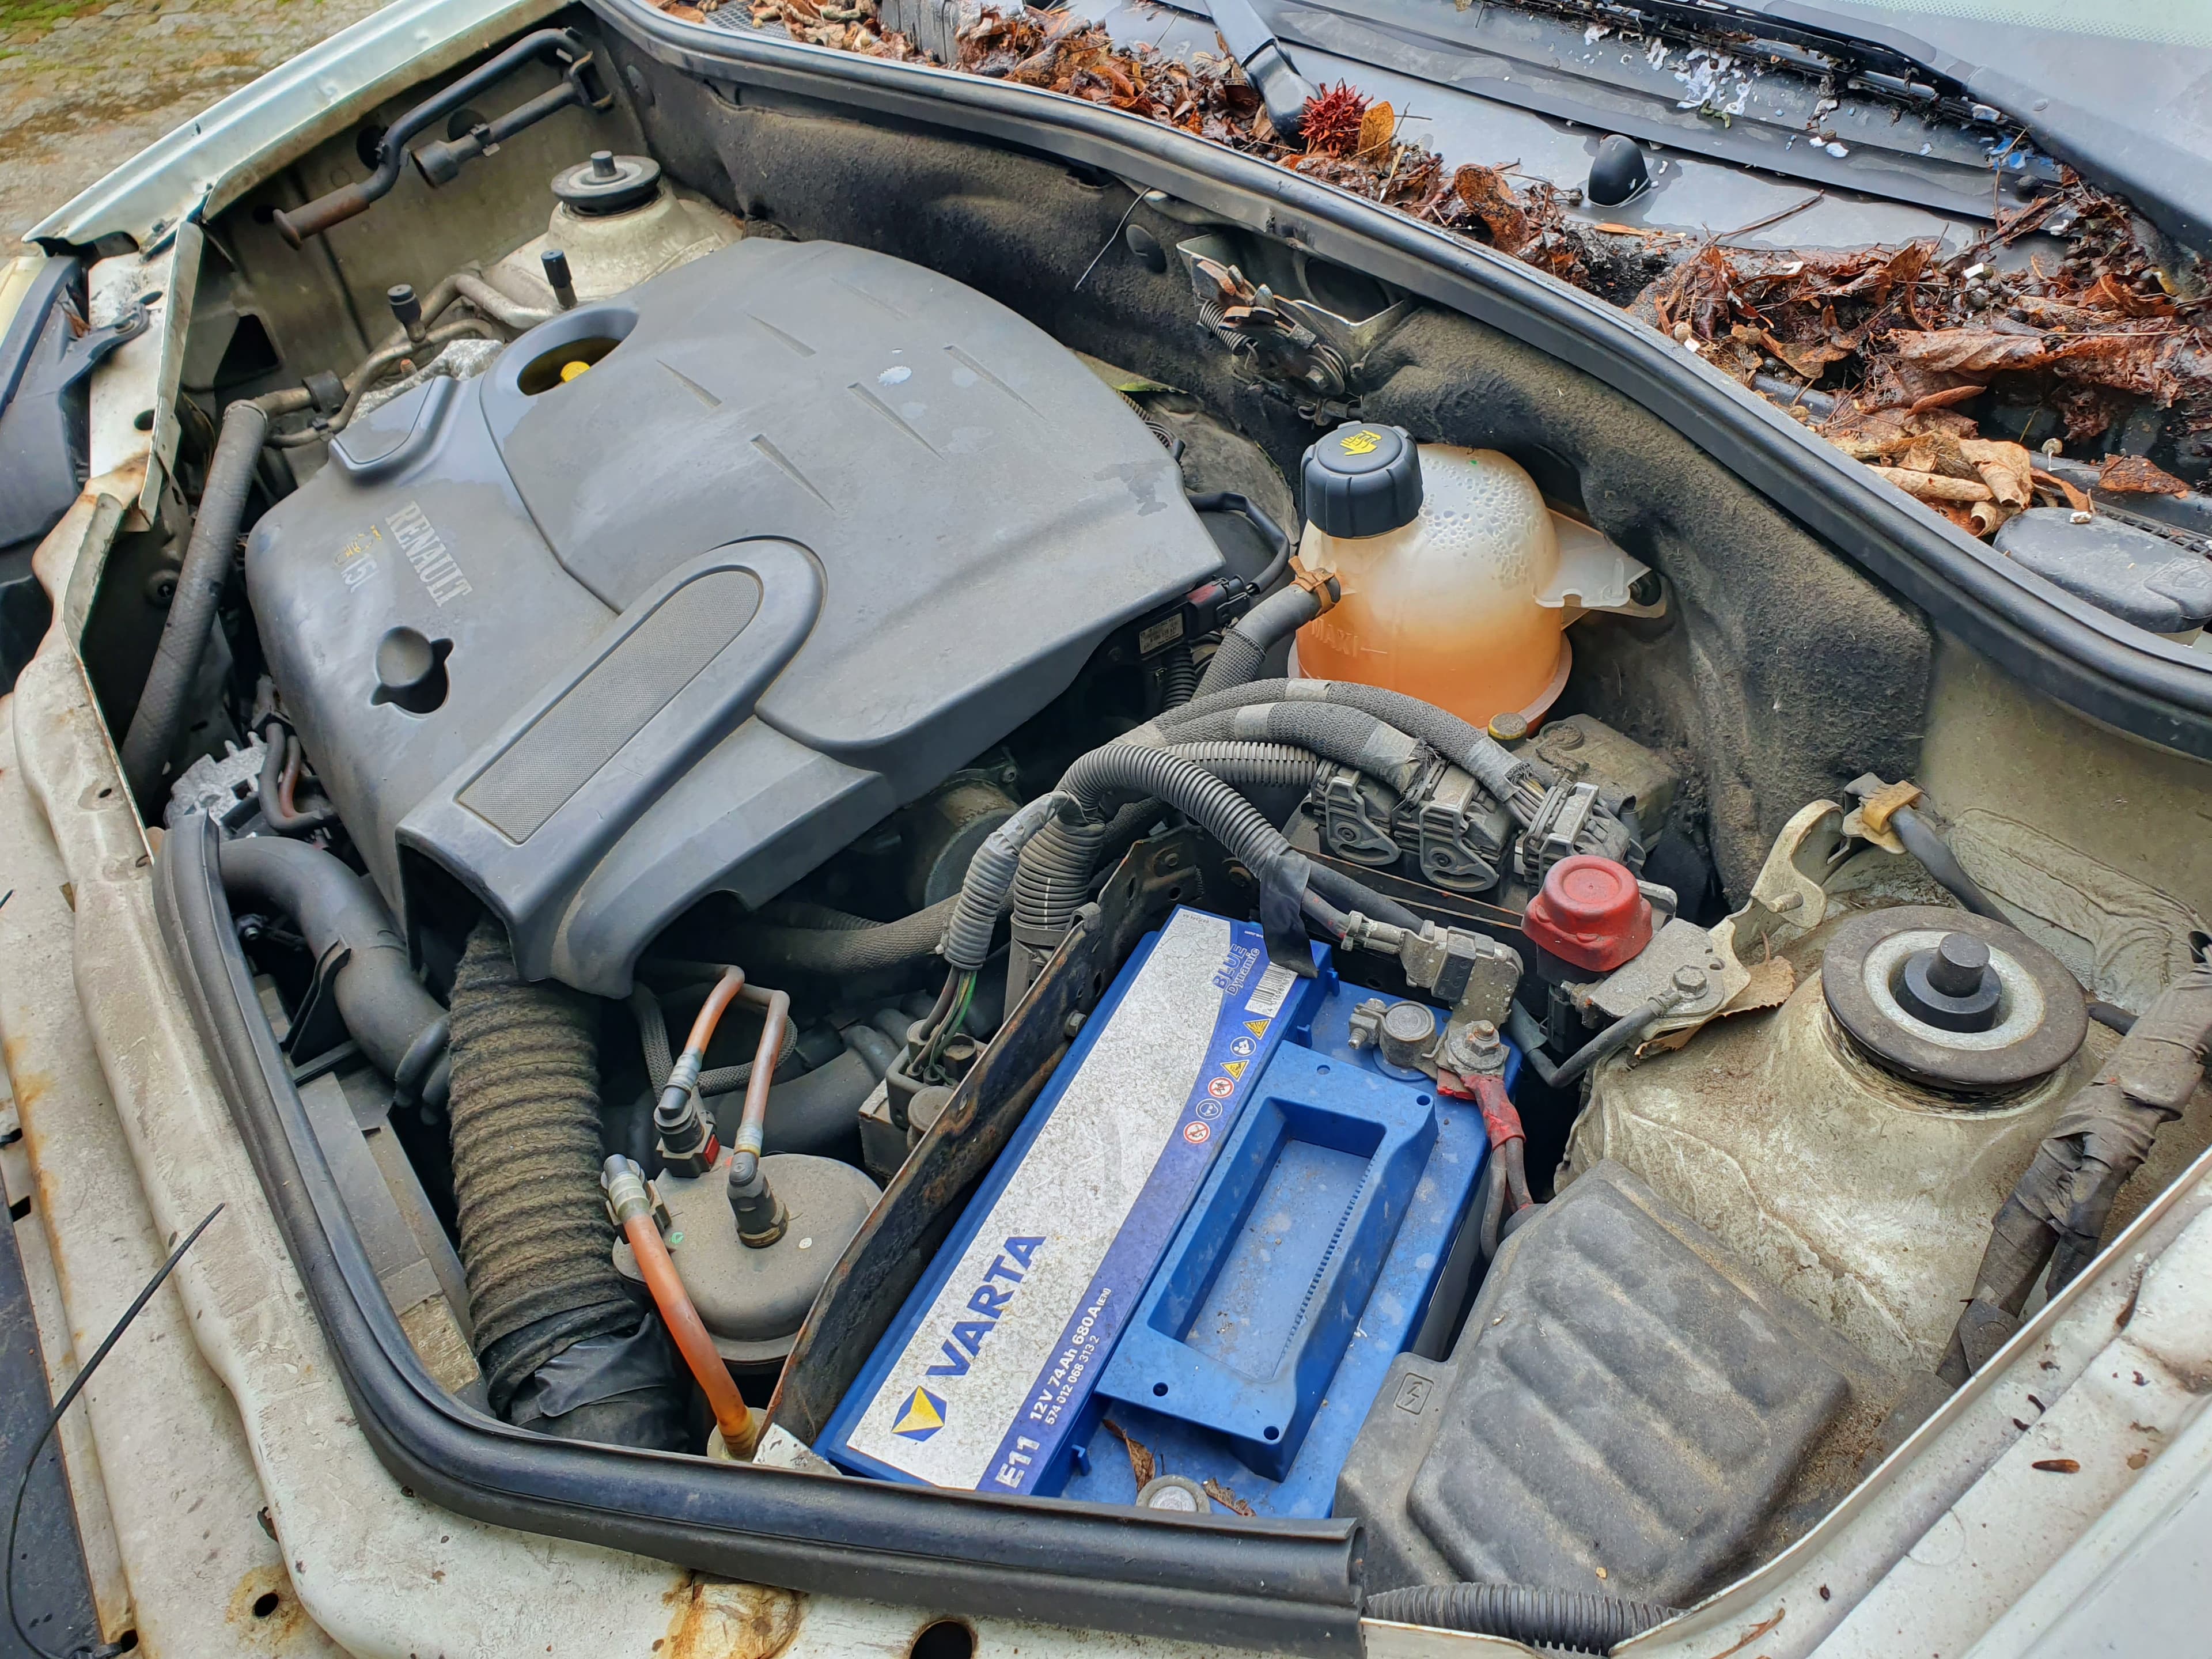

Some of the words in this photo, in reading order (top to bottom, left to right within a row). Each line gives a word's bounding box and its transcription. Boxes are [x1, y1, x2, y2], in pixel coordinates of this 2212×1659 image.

[385, 501, 473, 607] RENAULT
[1311, 618, 1359, 657] MAXI
[1212, 944, 1247, 990] BLUE
[1225, 948, 1260, 996] Dynamic
[925, 1236, 1047, 1376] VARTA
[995, 1435, 1040, 1488] E11
[1030, 1389, 1053, 1419] 12V
[1047, 1349, 1078, 1387] 74Ah
[1045, 1406, 1062, 1425] 574
[1057, 1385, 1073, 1404] 012
[1068, 1363, 1084, 1383] 068
[1079, 1344, 1094, 1363] 313
